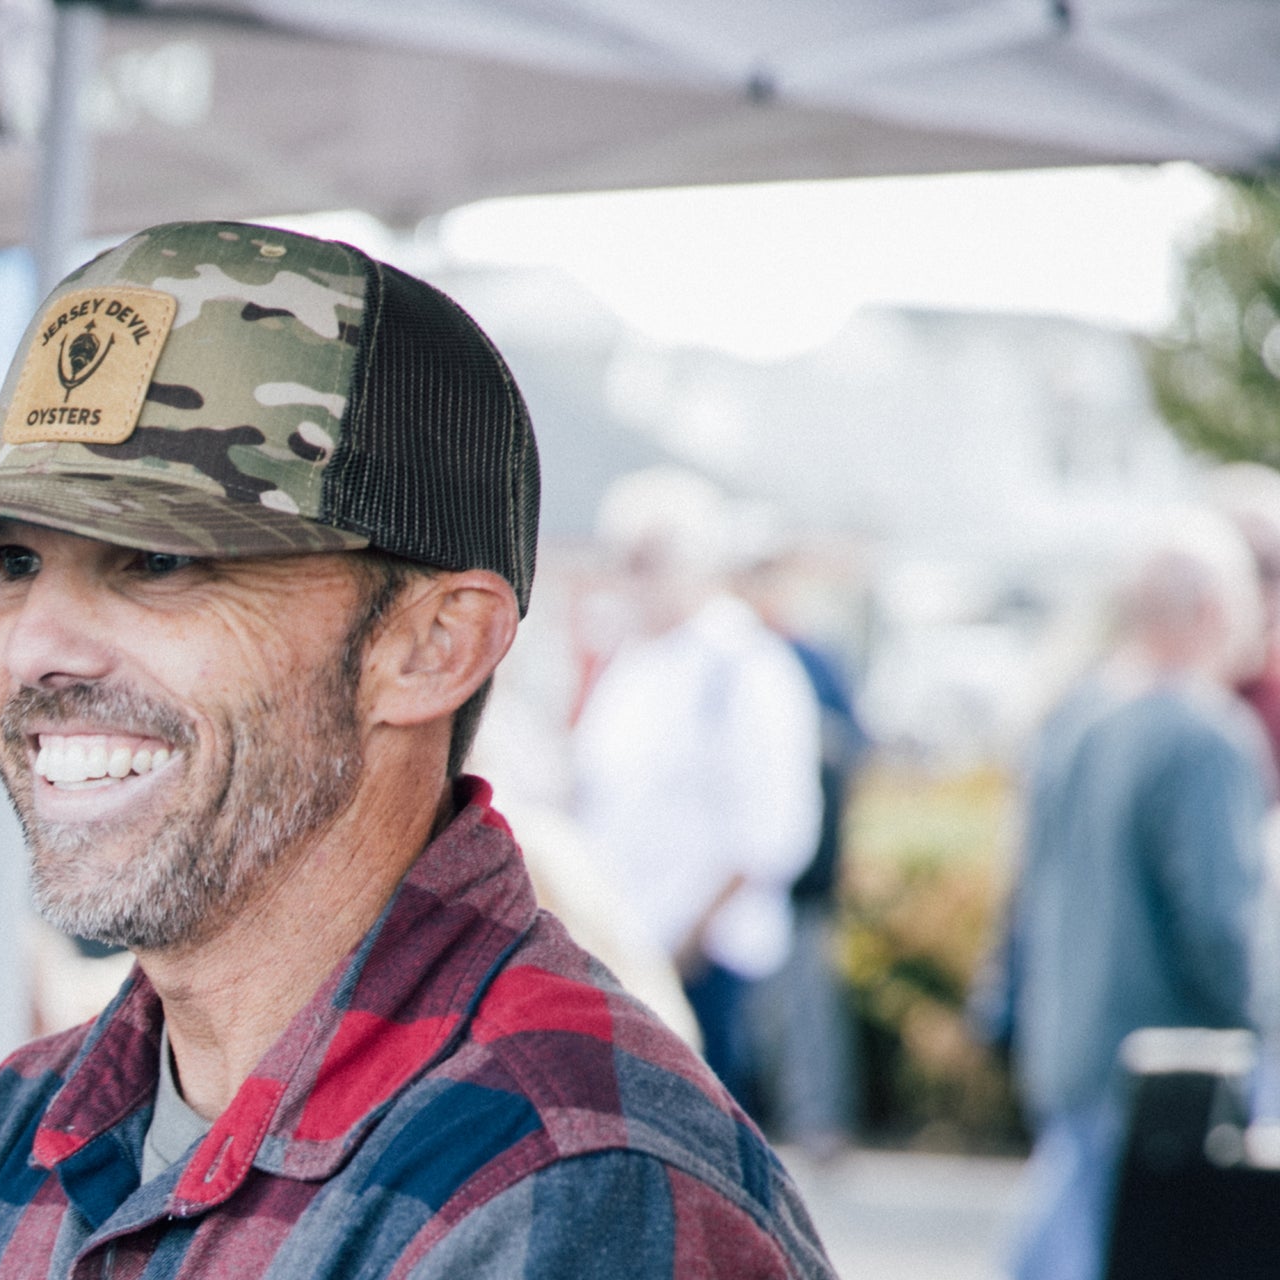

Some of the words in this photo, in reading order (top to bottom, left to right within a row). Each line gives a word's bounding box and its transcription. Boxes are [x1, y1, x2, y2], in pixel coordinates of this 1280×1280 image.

[42, 298, 105, 346] JERSEY
[106, 300, 150, 345] DEVIL
[26, 407, 102, 426] OYSTERS
